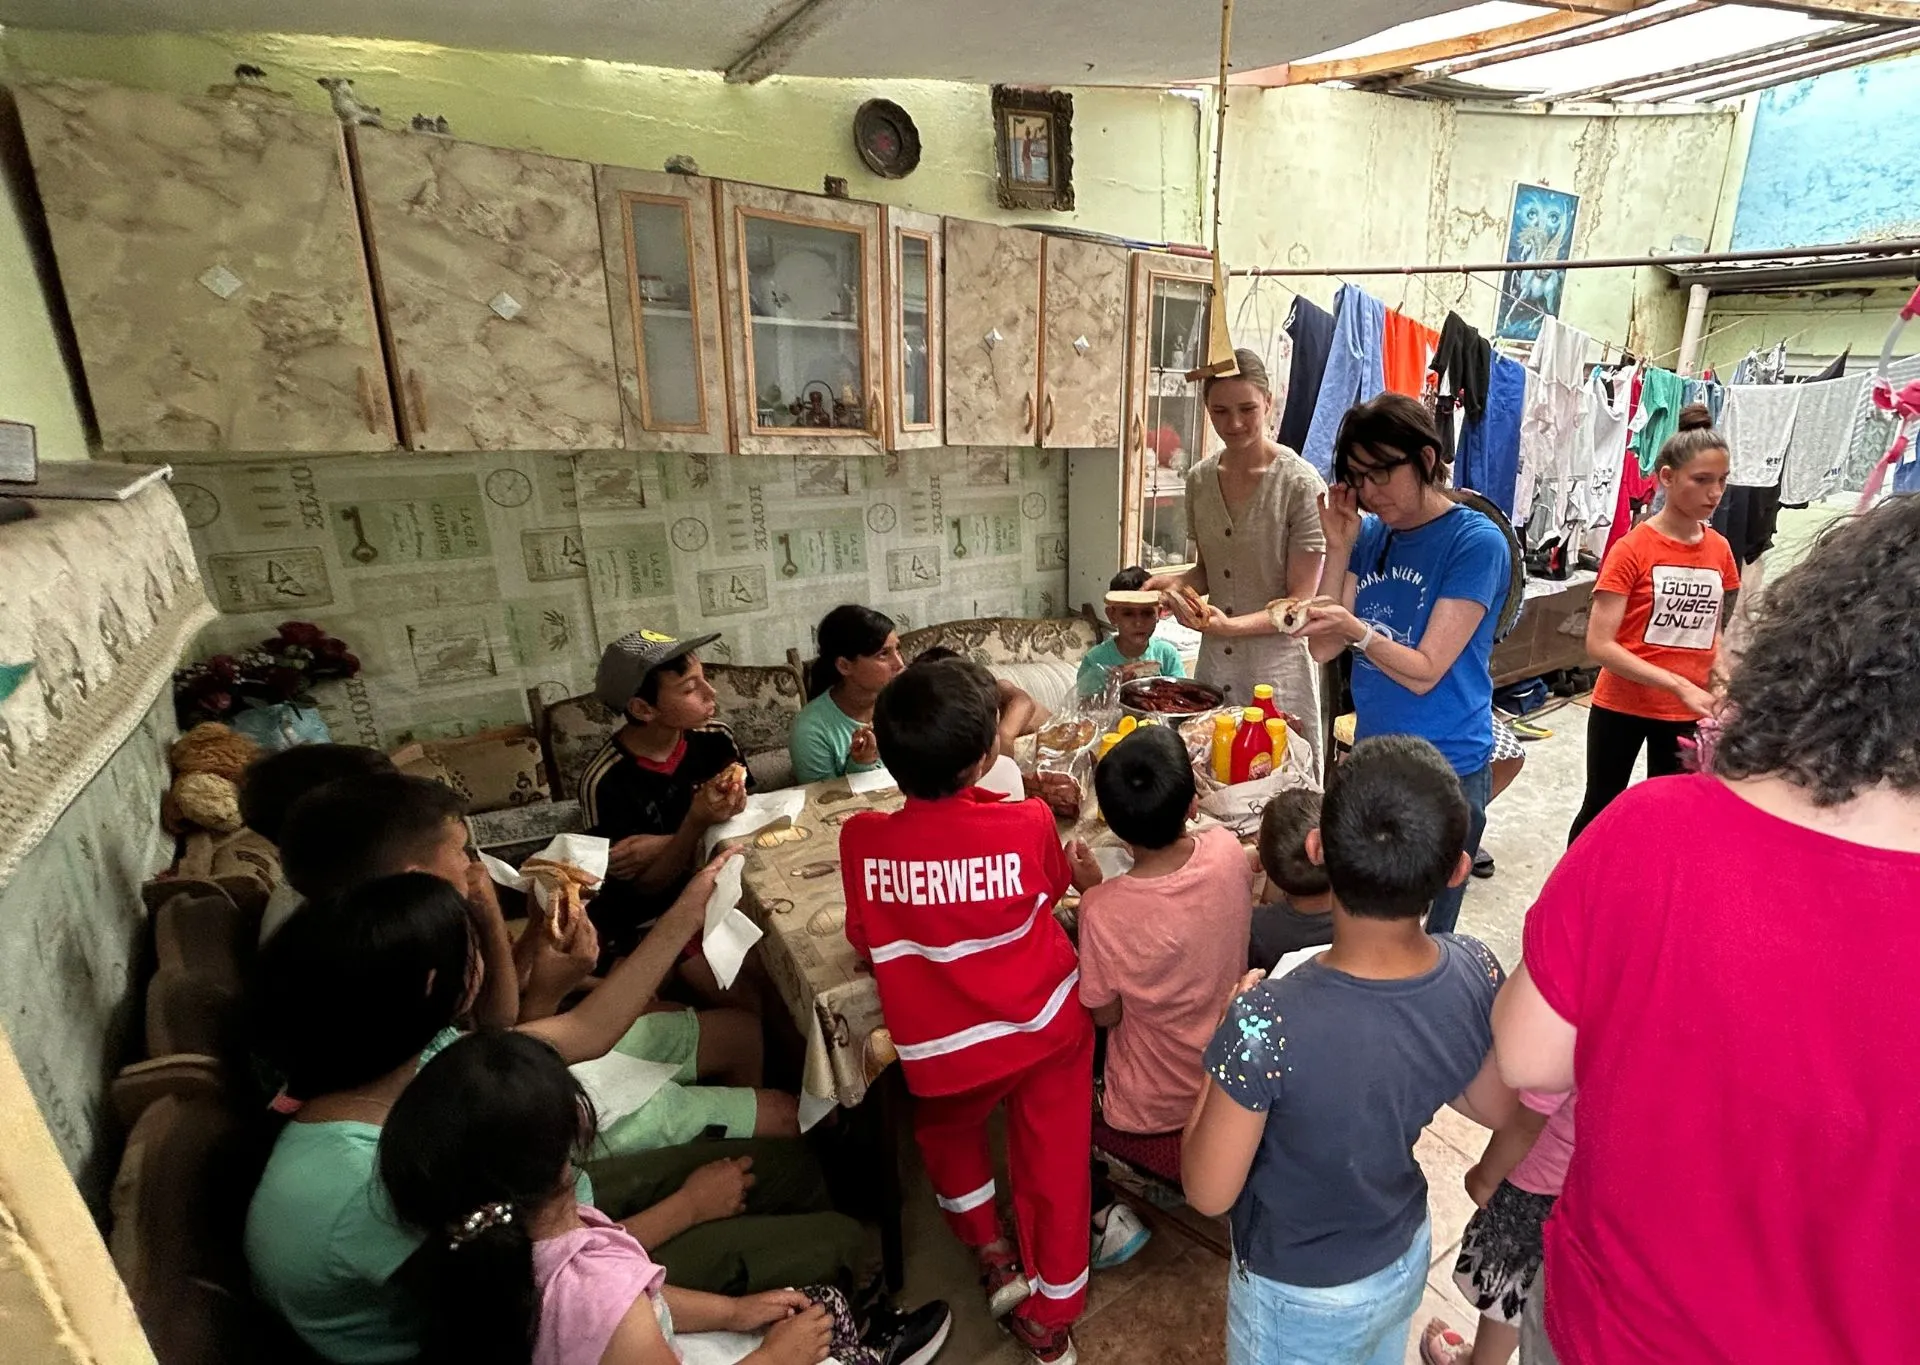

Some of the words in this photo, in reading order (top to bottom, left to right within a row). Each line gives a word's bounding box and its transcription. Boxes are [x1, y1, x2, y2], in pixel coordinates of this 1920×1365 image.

[290, 466, 324, 529] OME
[749, 485, 768, 551] HOME
[930, 473, 944, 535] HOME
[1661, 581, 1712, 598] GOOD
[1666, 598, 1718, 614] VIBES
[1653, 612, 1704, 629] ONLY
[863, 852, 1024, 906] FEUERWEHR
